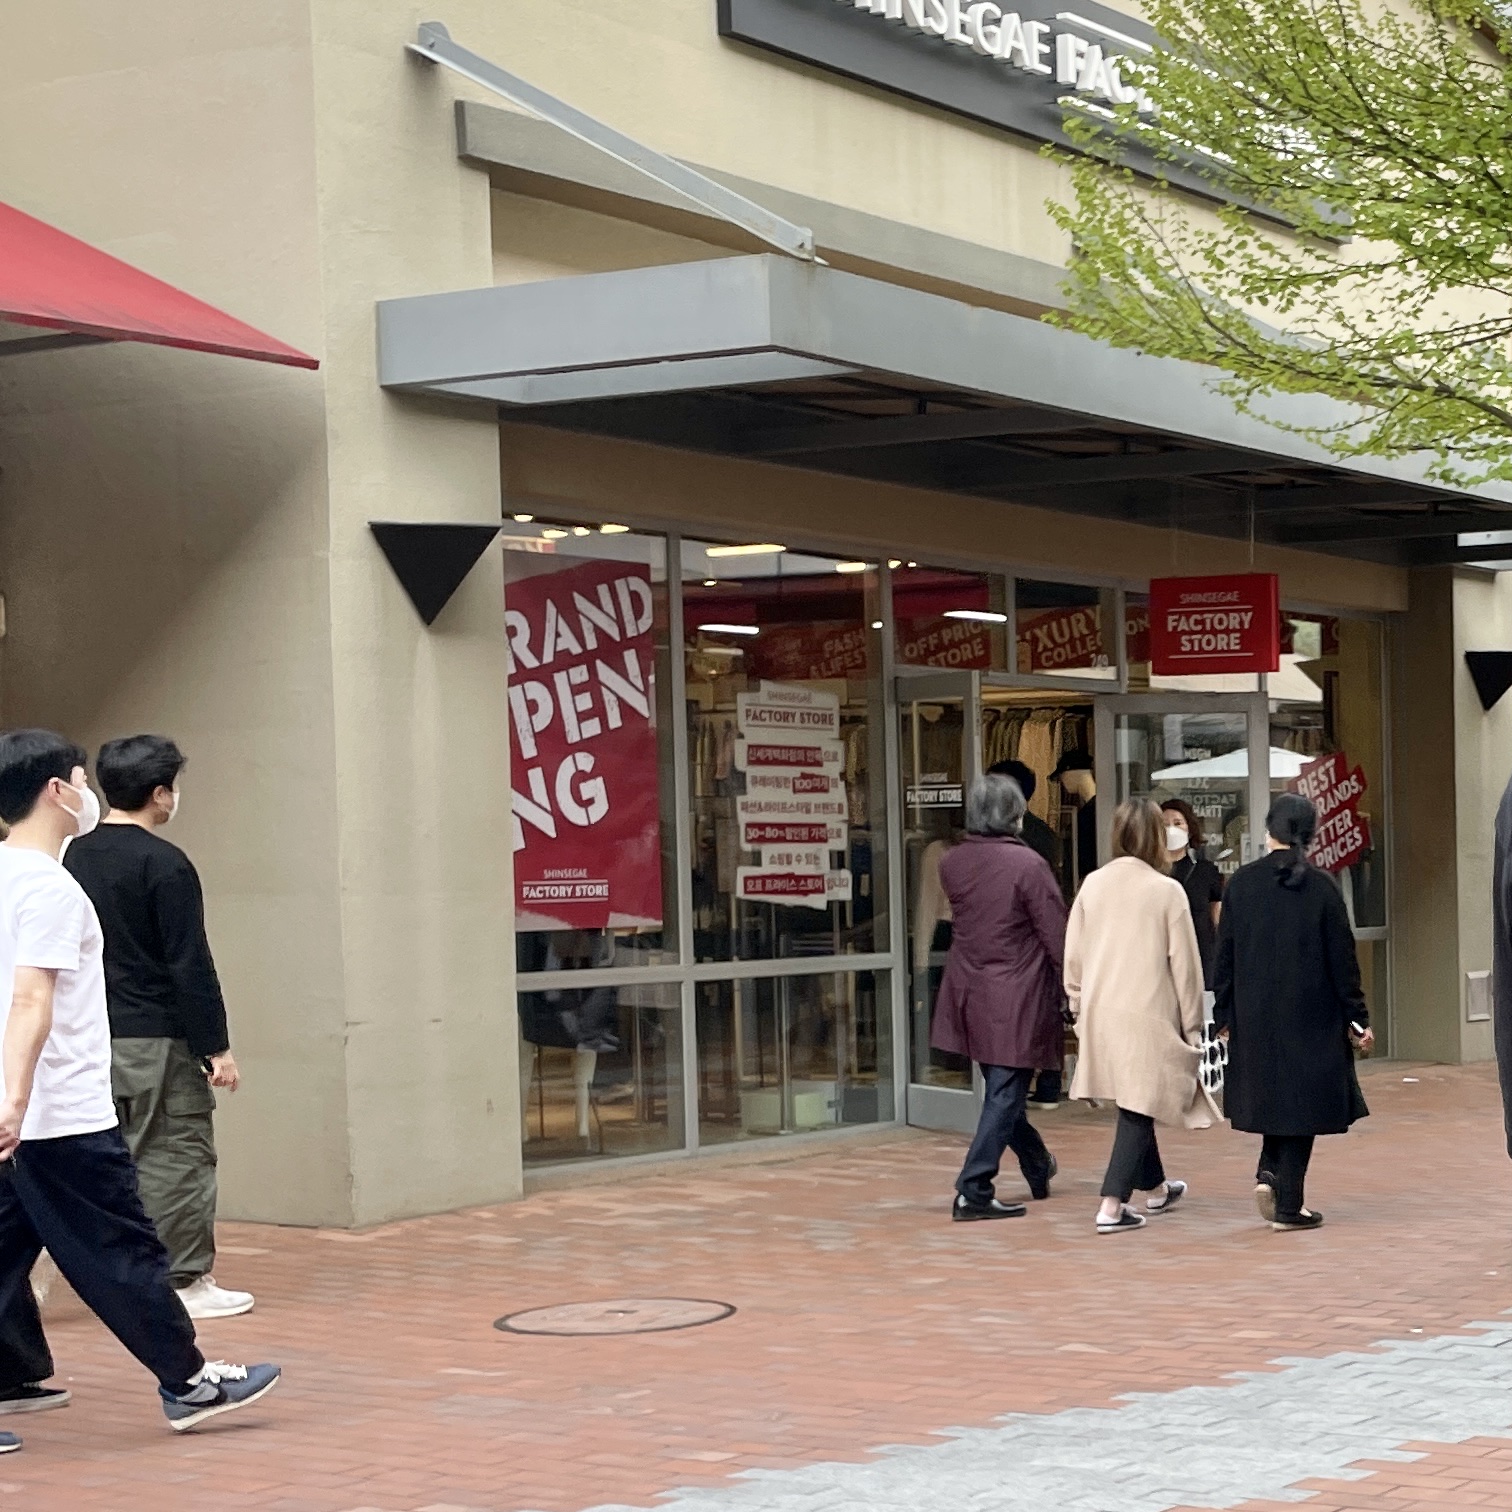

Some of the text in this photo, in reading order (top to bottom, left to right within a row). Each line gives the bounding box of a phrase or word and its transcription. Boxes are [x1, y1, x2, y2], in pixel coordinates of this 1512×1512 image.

[504, 575, 653, 675] RAND
[1167, 612, 1253, 632] FACTORY
[1181, 633, 1242, 651] STORE
[508, 649, 650, 760] PEN
[745, 708, 835, 726] FACTORY STORE
[511, 751, 610, 852] NG
[1316, 774, 1363, 817] RANDS,
[543, 868, 589, 879] SHINSEGAE
[522, 884, 609, 898] FACTORY STORE
